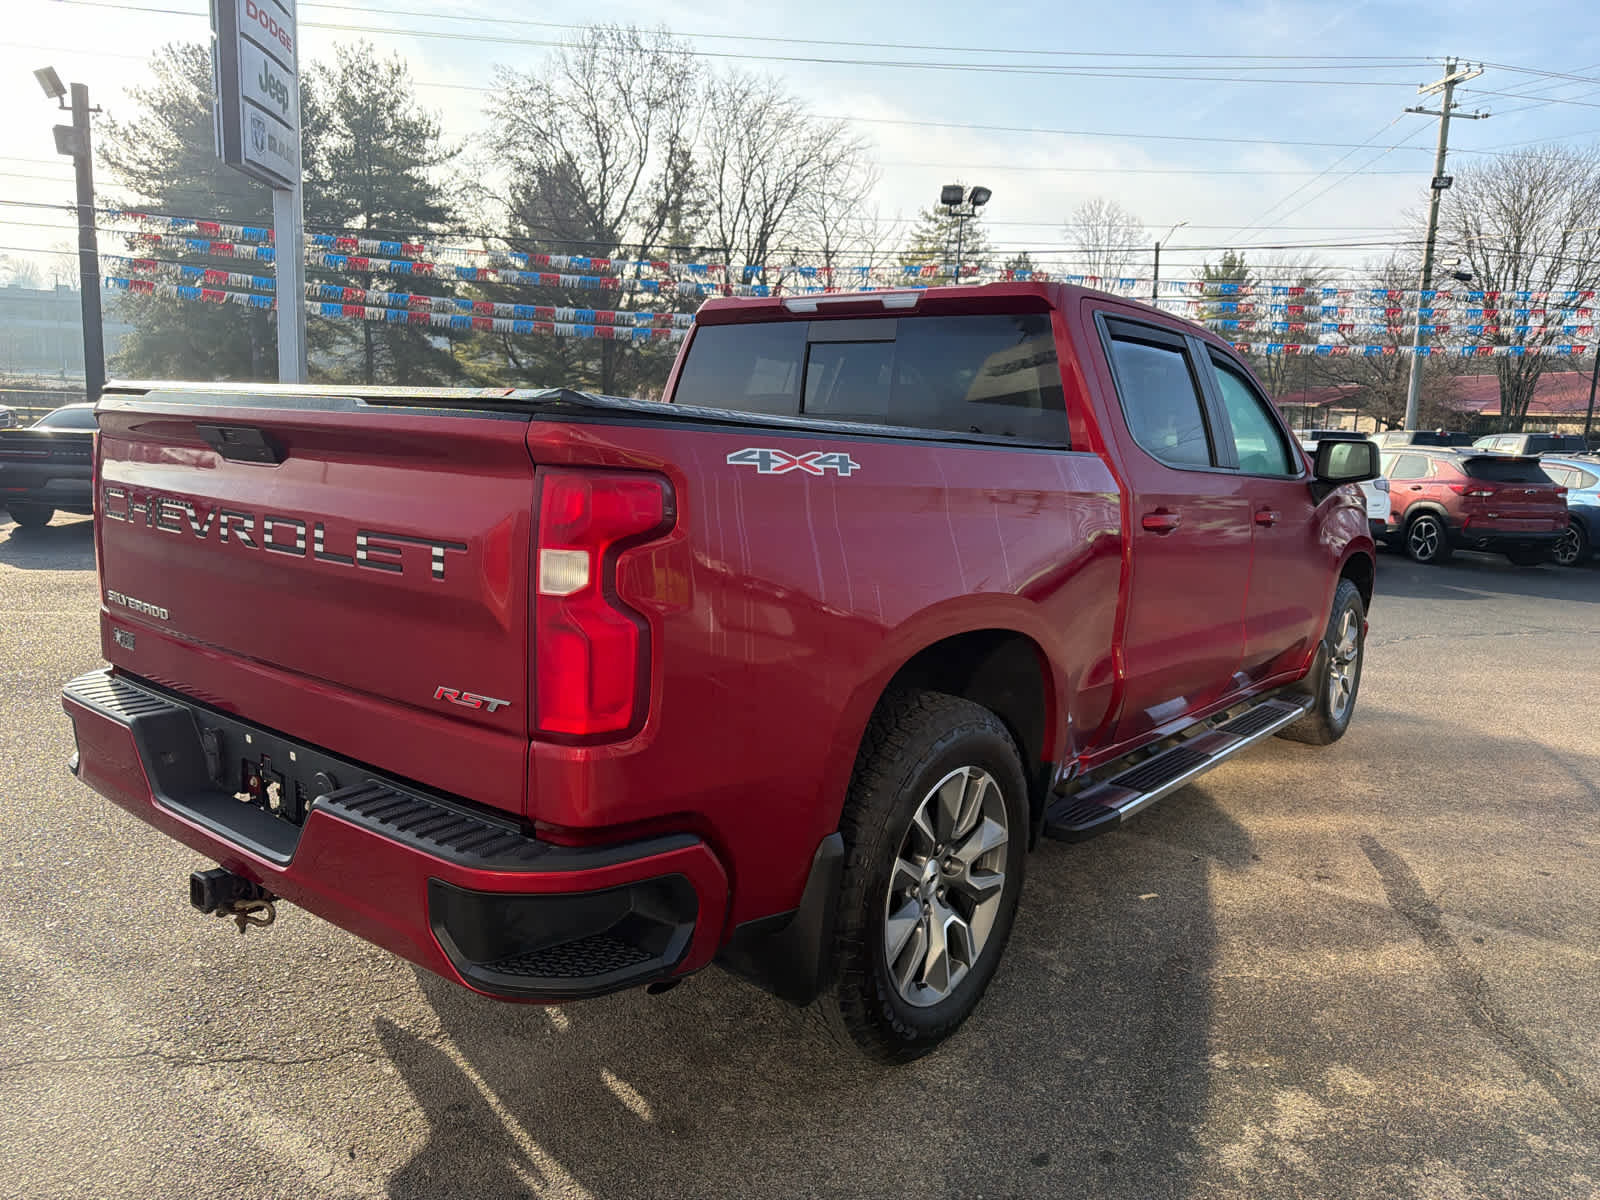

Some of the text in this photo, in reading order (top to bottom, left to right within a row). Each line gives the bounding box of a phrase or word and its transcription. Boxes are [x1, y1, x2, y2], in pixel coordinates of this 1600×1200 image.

[245, 0, 292, 53] DODGE
[258, 59, 289, 114] Jeep
[104, 487, 468, 582] CHEVROLET
[107, 589, 169, 620] SILVERADO
[433, 685, 512, 713] RST
